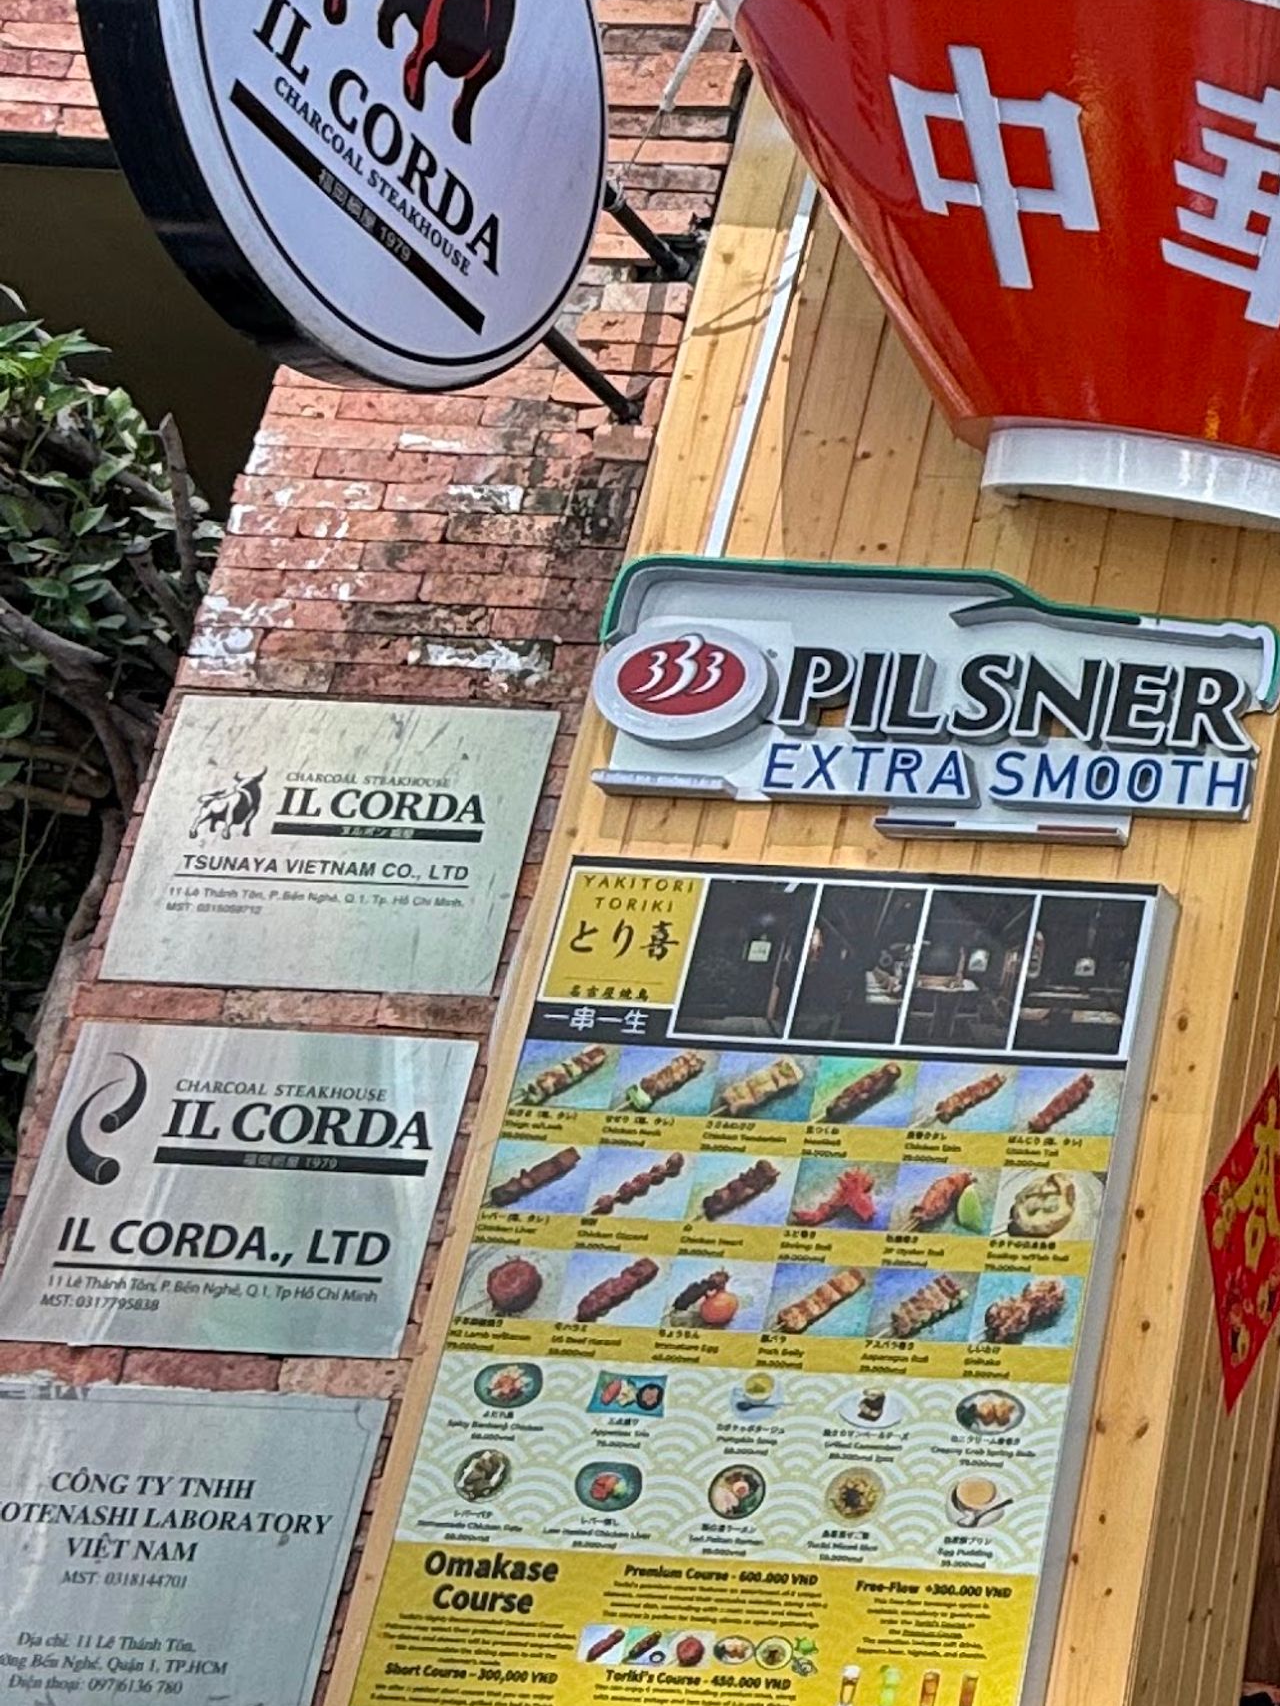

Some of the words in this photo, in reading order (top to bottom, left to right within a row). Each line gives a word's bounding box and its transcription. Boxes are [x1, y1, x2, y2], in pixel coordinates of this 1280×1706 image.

[273, 75, 364, 176] CHARCOAL
[367, 169, 472, 276] STEAKHOUSE
[329, 68, 500, 277] CORDA
[632, 633, 725, 703] 333
[772, 645, 1258, 754] PILSNER
[286, 772, 358, 787] CHARCOAL
[761, 742, 970, 799] EXTRA
[989, 749, 1251, 810] SMOOTH
[276, 786, 322, 818] IL
[330, 788, 486, 825] CORDA
[183, 854, 278, 875] TSUNAYA
[286, 859, 375, 878] VIETNAM
[382, 863, 421, 881] CO.,
[429, 865, 469, 881] LTD
[583, 874, 695, 894] YAKITORI
[595, 897, 674, 913] TORIKI
[570, 918, 681, 962] とり喜
[543, 1006, 650, 1035] 一串一生
[176, 1078, 268, 1097] CHARCOAL
[275, 1083, 388, 1103] STEAKHOUSE
[161, 1098, 220, 1142] IL
[231, 1101, 434, 1152] CORDA
[56, 1216, 96, 1253] IL
[110, 1219, 294, 1268] CORDA.,
[306, 1229, 392, 1267] LTD
[51, 1466, 130, 1495] CÔNG
[137, 1474, 174, 1496] TY
[179, 1476, 257, 1500] TNHH
[0, 1500, 139, 1528] OTENASHI
[143, 1507, 335, 1536] LABORATORY
[67, 1532, 130, 1565] VIỆT
[133, 1539, 198, 1563] NAM
[424, 1549, 559, 1583] Omakase
[624, 1564, 683, 1579] Premium
[686, 1567, 729, 1582] Course
[792, 1571, 818, 1586] VND
[432, 1584, 534, 1614] Course
[855, 1580, 919, 1595] Free-Flow
[385, 1662, 421, 1677] Short
[424, 1664, 466, 1680] Course
[657, 1671, 701, 1687] Course
